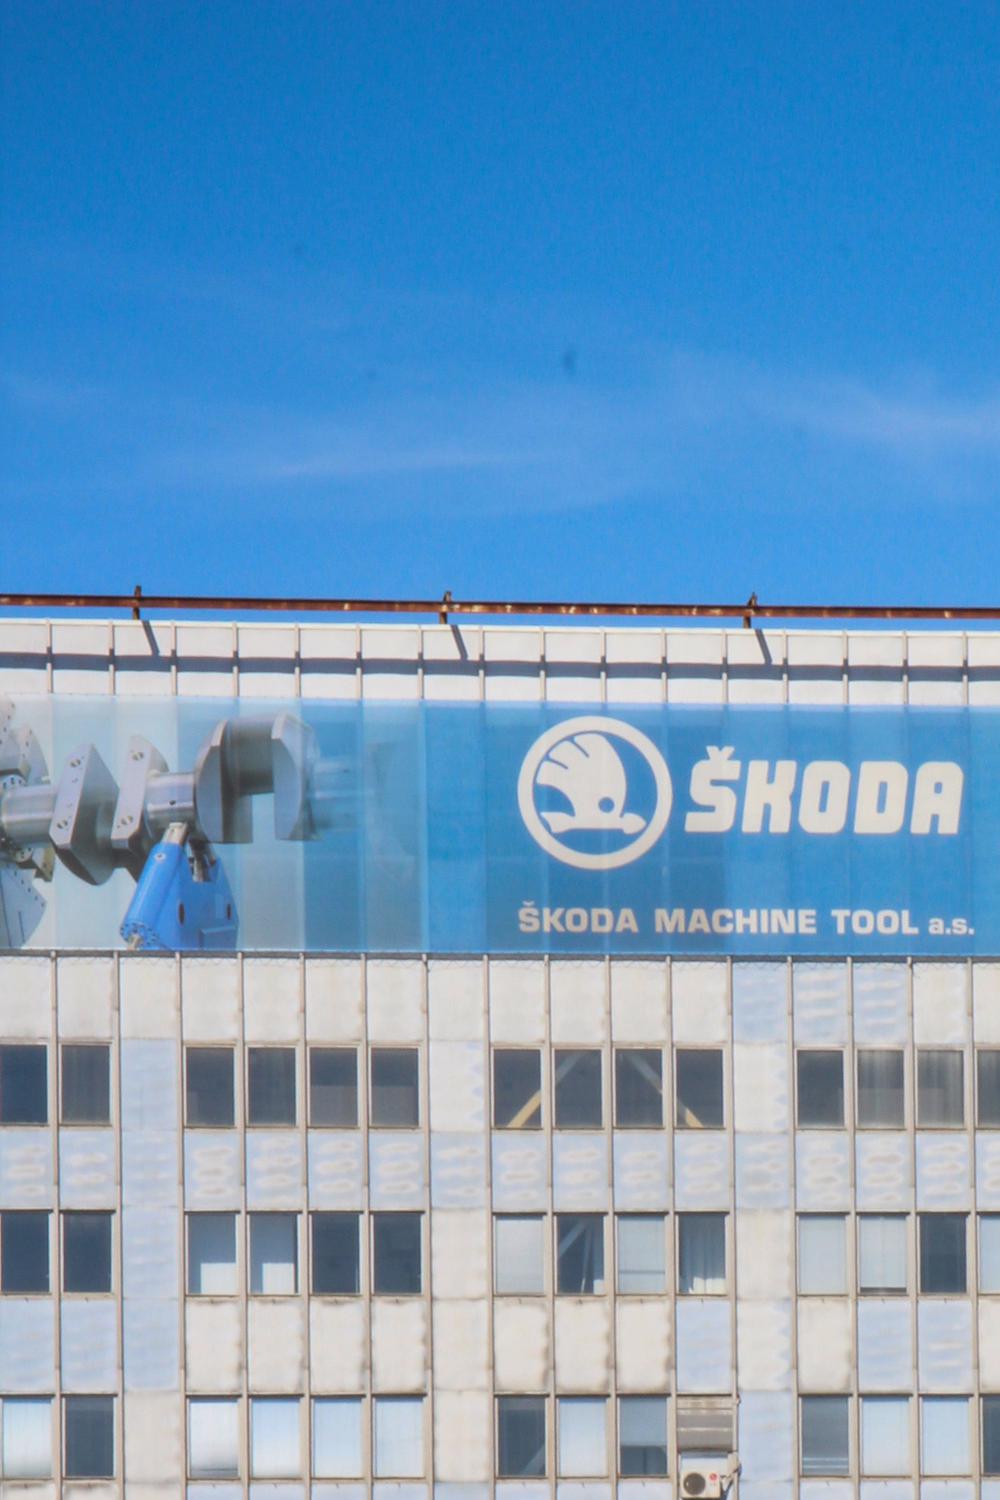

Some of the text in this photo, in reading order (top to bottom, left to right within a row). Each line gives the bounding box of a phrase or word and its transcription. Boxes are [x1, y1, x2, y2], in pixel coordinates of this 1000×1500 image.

[685, 746, 963, 834] ŠKODA
[518, 901, 975, 935] ŠKODA MACHINE TOOL a.s.
